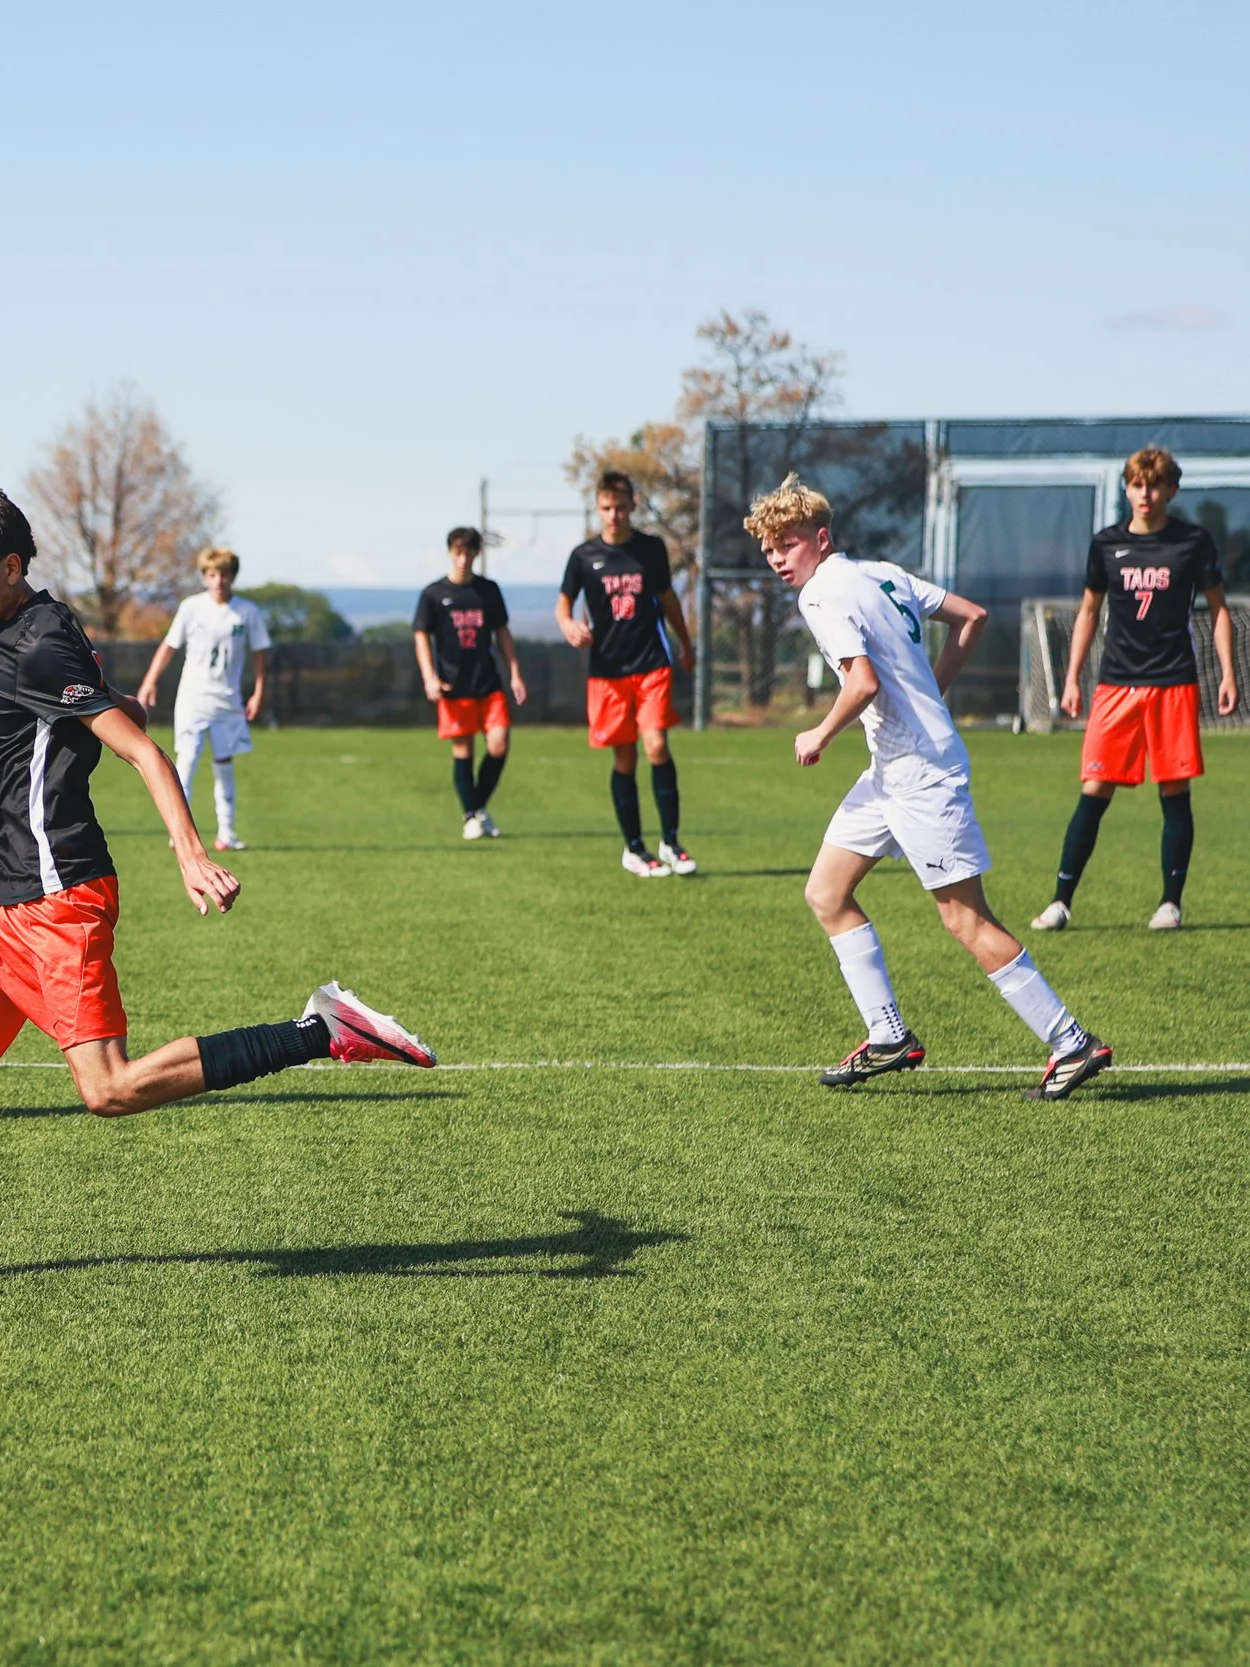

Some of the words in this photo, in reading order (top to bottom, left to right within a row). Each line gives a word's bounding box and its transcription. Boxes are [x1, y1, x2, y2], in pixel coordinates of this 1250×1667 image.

[601, 573, 643, 595] TAOS
[1120, 566, 1170, 591] TAOS
[879, 580, 921, 644] 5
[1135, 590, 1153, 621] 7
